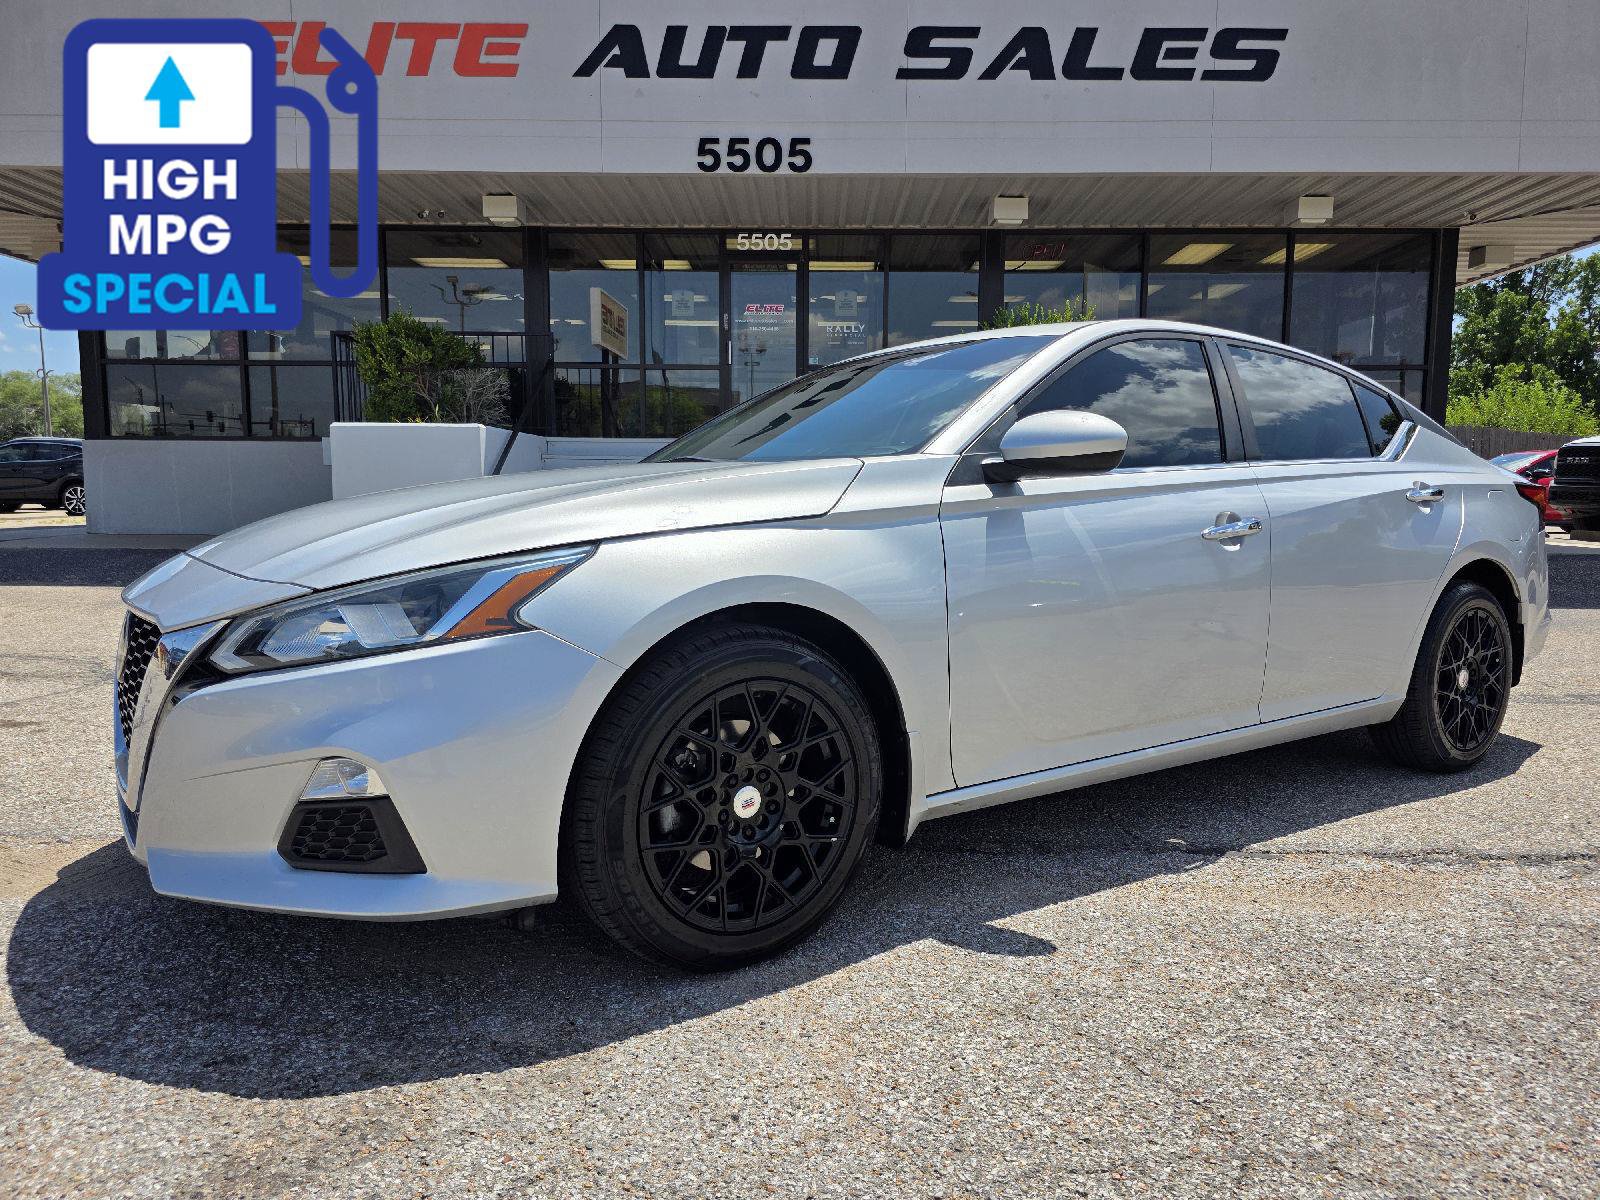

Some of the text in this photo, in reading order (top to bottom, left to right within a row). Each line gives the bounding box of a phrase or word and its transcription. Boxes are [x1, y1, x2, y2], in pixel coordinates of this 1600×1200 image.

[572, 24, 862, 80] AUTO
[895, 26, 1290, 82] SALES
[697, 136, 813, 173] 5505
[736, 233, 793, 251] 5505
[745, 304, 784, 313] ELITE
[826, 324, 866, 333] RALLY
